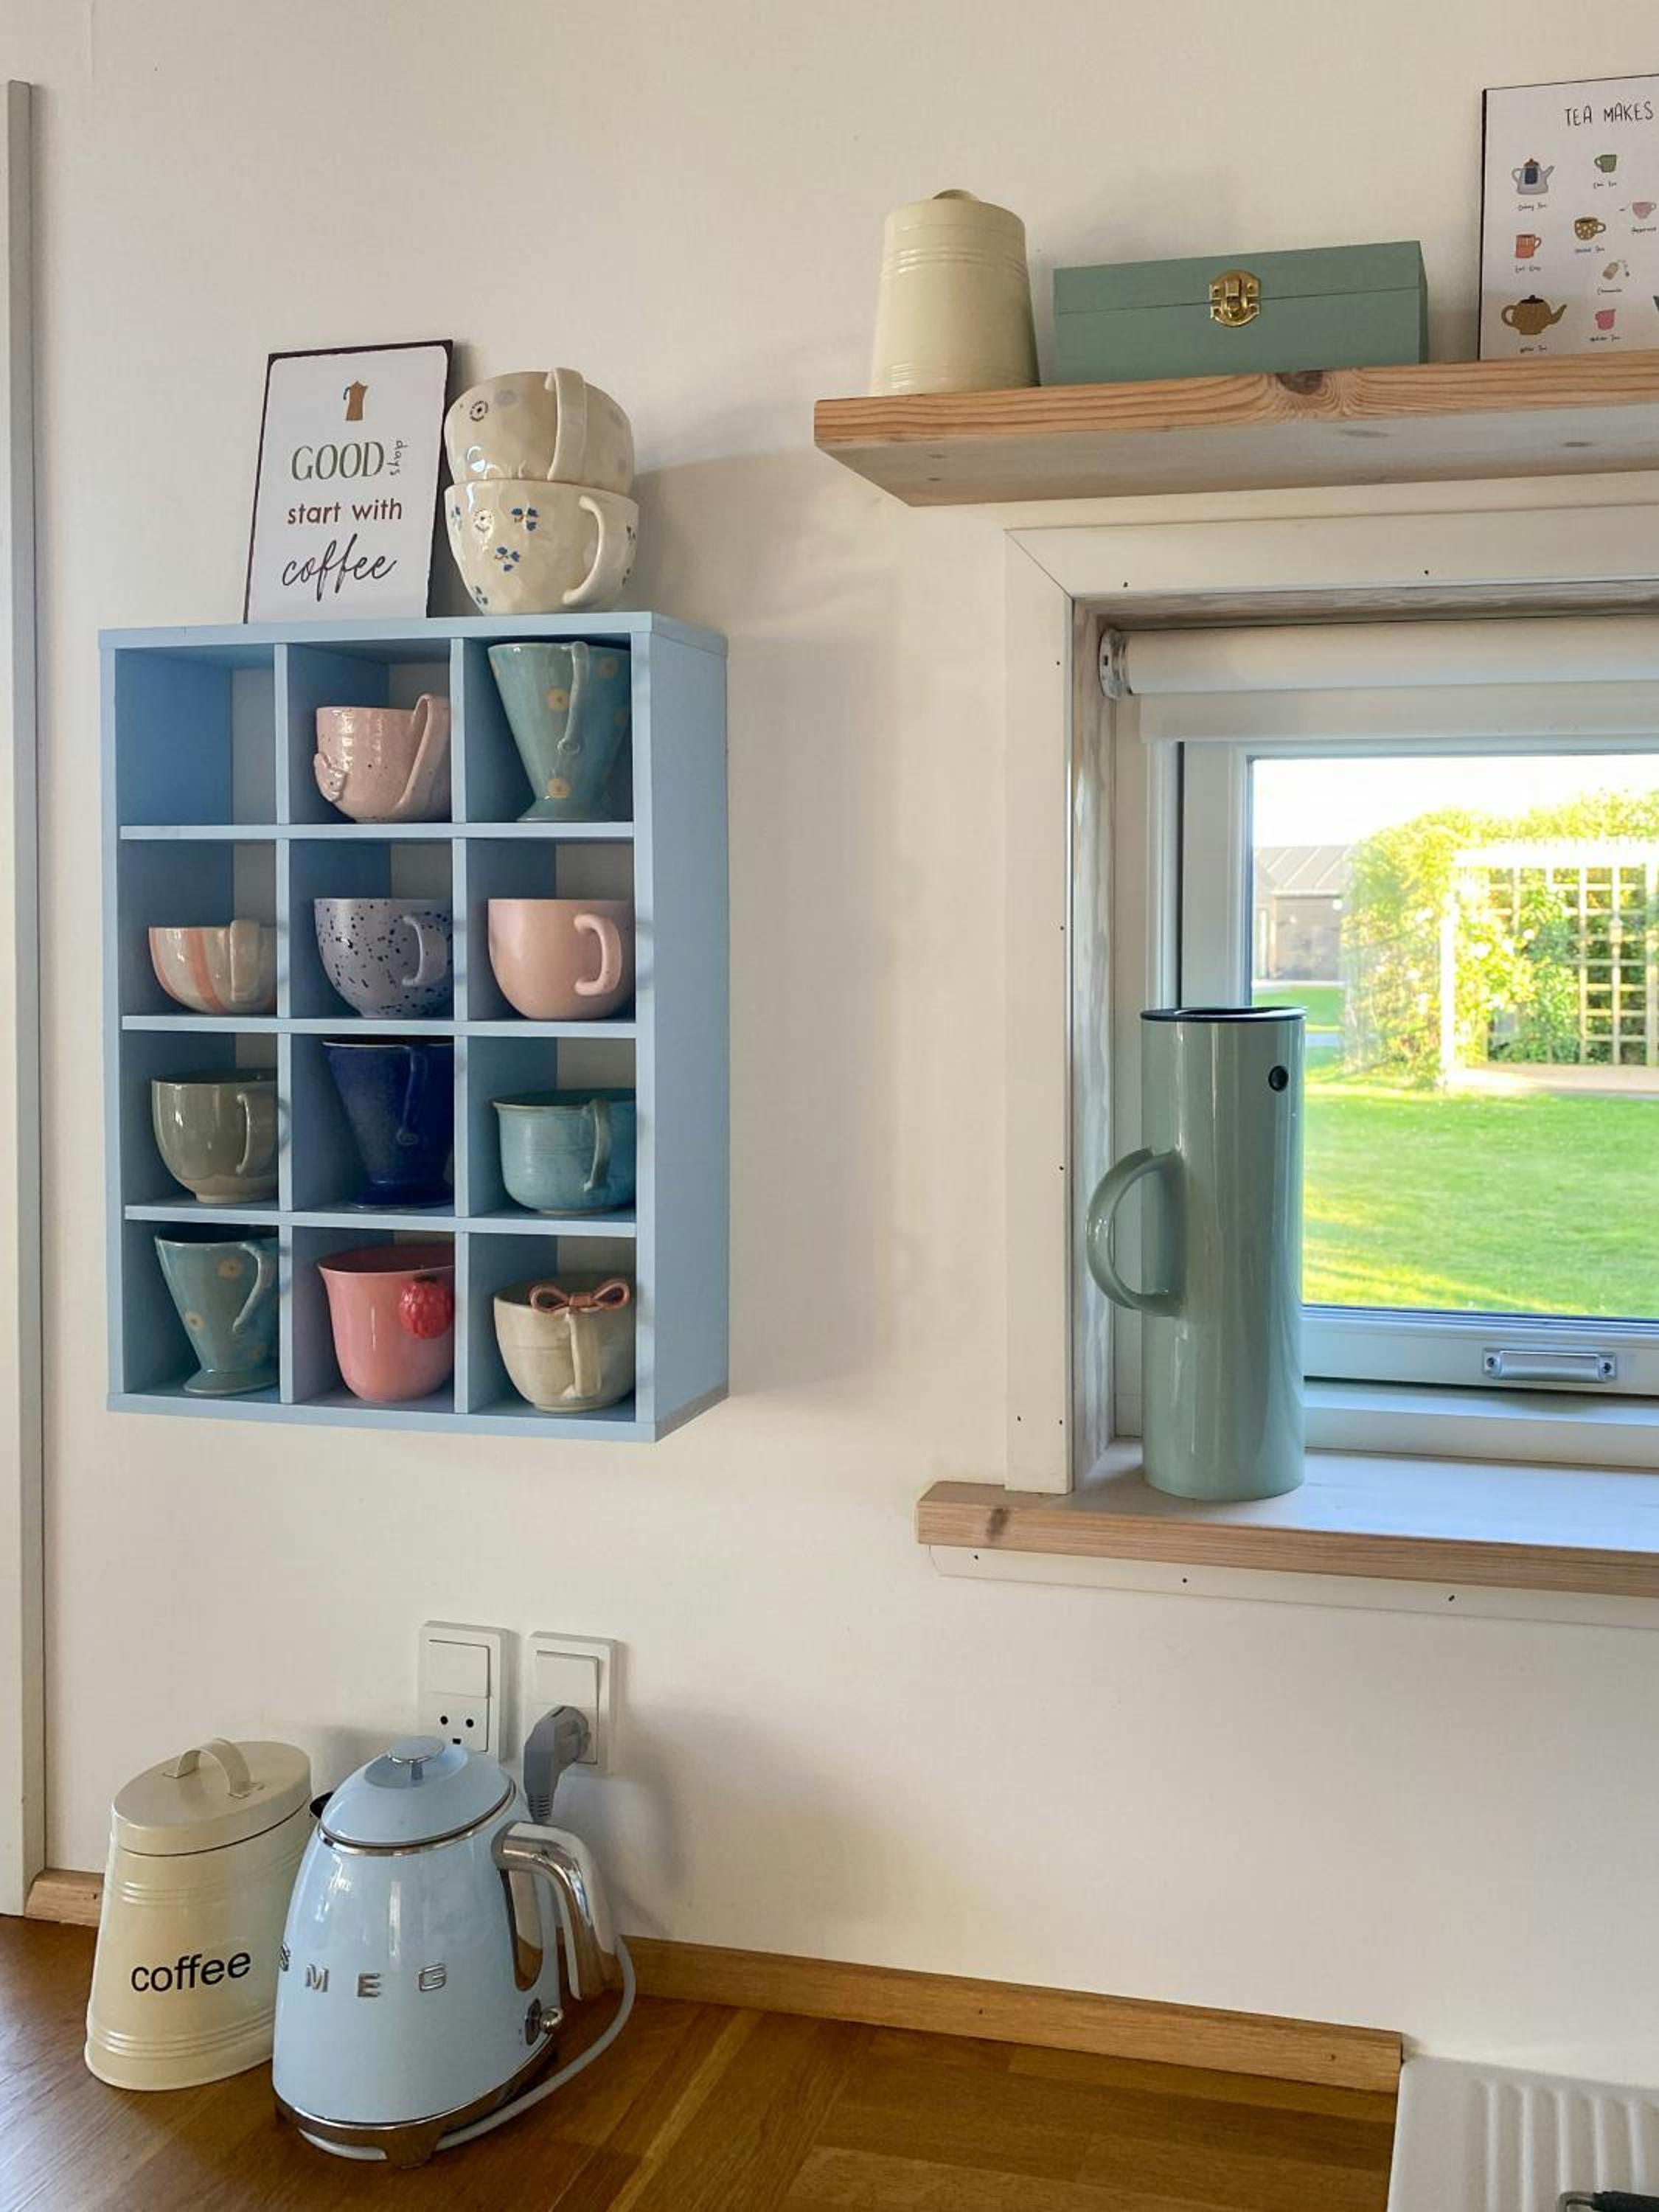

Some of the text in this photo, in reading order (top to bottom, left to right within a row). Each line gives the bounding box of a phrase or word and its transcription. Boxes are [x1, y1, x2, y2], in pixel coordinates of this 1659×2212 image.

[1565, 100, 1654, 127] TEA MAKES
[291, 439, 408, 481] GOOD days
[287, 497, 403, 525] start with
[282, 532, 397, 602] coffee
[131, 1951, 251, 1992] coffee
[279, 1942, 447, 1998] SMEG
